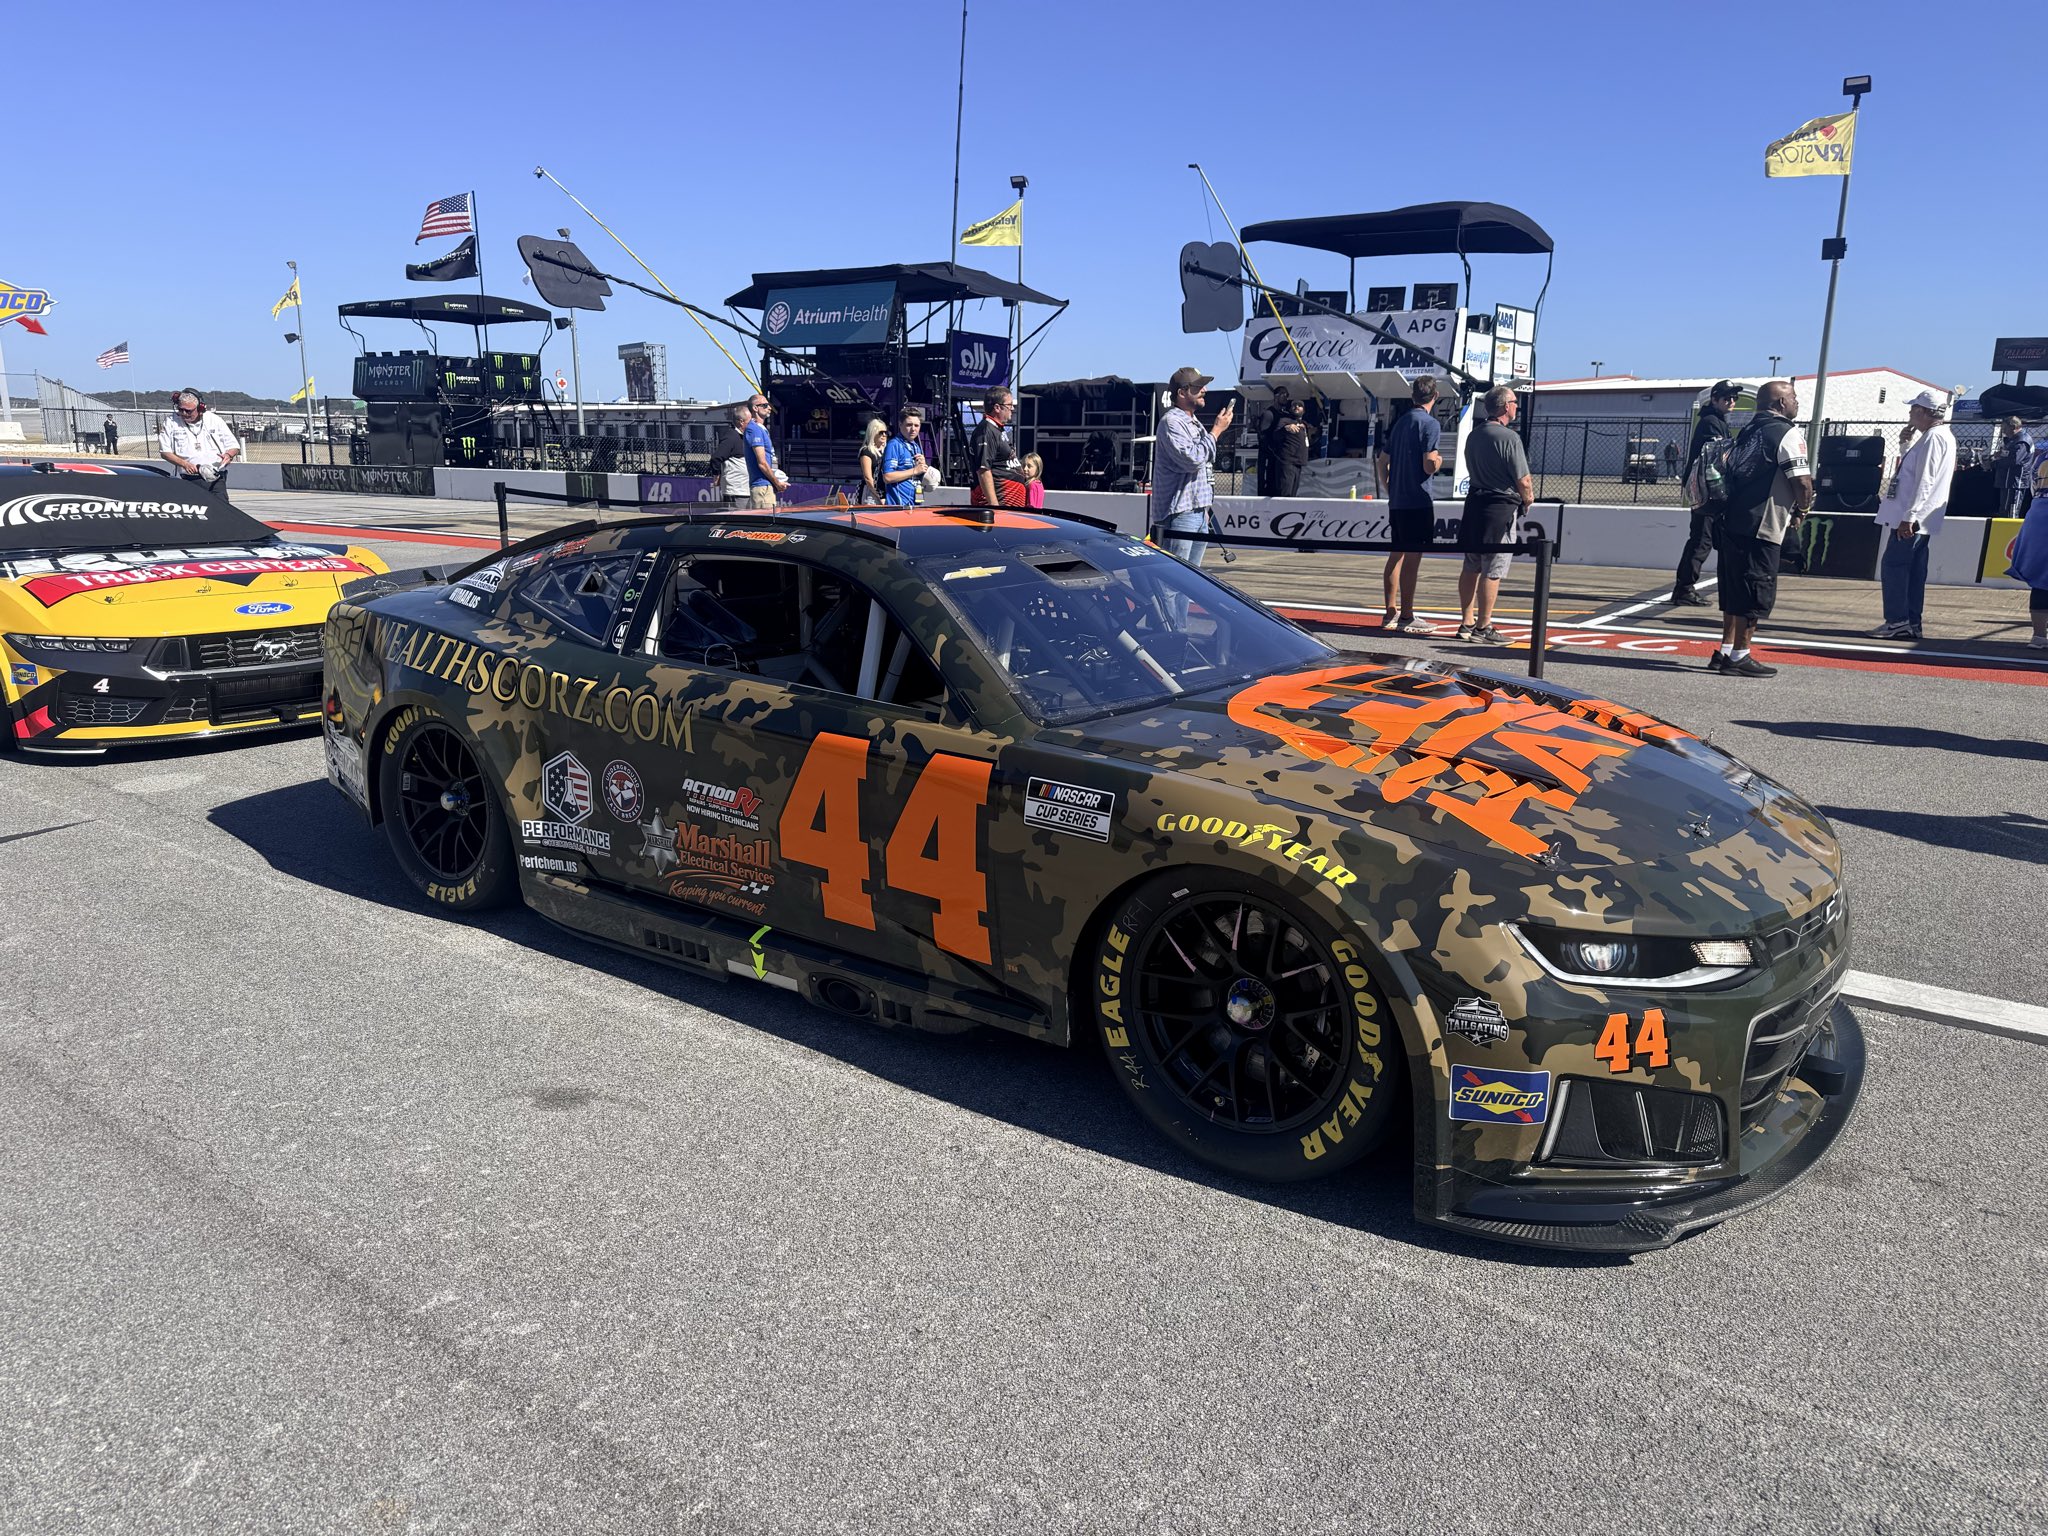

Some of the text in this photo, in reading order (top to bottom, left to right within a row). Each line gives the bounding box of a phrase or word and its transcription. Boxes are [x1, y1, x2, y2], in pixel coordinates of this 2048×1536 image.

[793, 303, 888, 326] Atrium Health
[1407, 317, 1447, 334] APG
[1291, 326, 1312, 338] The
[960, 342, 997, 378] ally
[1250, 325, 1355, 374] Gracie
[368, 364, 411, 378] MONSTER
[882, 376, 893, 388] 48
[1957, 438, 1989, 448] YOTA
[302, 466, 411, 484] MONSTER MONSTER
[48, 513, 208, 521] MOTORSPORTS
[1224, 513, 1261, 530] APG
[1310, 509, 1328, 521] The
[65, 557, 348, 587] TRUCK CENTERS
[247, 603, 285, 615] Ford
[93, 678, 110, 693] 4
[373, 617, 696, 754] WEALTHSCORZ.COM
[606, 764, 640, 788] UNDERGROUND
[682, 778, 765, 818] ACTION RV
[1053, 786, 1102, 809] NASCAR
[621, 803, 641, 819] BREAKS
[686, 804, 759, 831] NOW HIRING TECHNICIANS
[730, 808, 744, 816] PARTS
[1035, 804, 1099, 829] CUP SERIES
[522, 820, 611, 851] PERFORMANCE
[676, 821, 771, 869] Marshall
[779, 731, 993, 966] 44
[1157, 813, 1358, 889] GOODYEAR
[680, 849, 775, 885] Electrical Services
[426, 876, 477, 903] EAGLE
[668, 879, 767, 916] Keeping you current
[1100, 924, 1131, 1048] EAGLE
[1447, 1017, 1507, 1040] TAILGATING
[1300, 938, 1384, 1161] GOODYEAR
[1594, 1008, 1669, 1074] 44
[1456, 1088, 1542, 1108] SUNOCO
